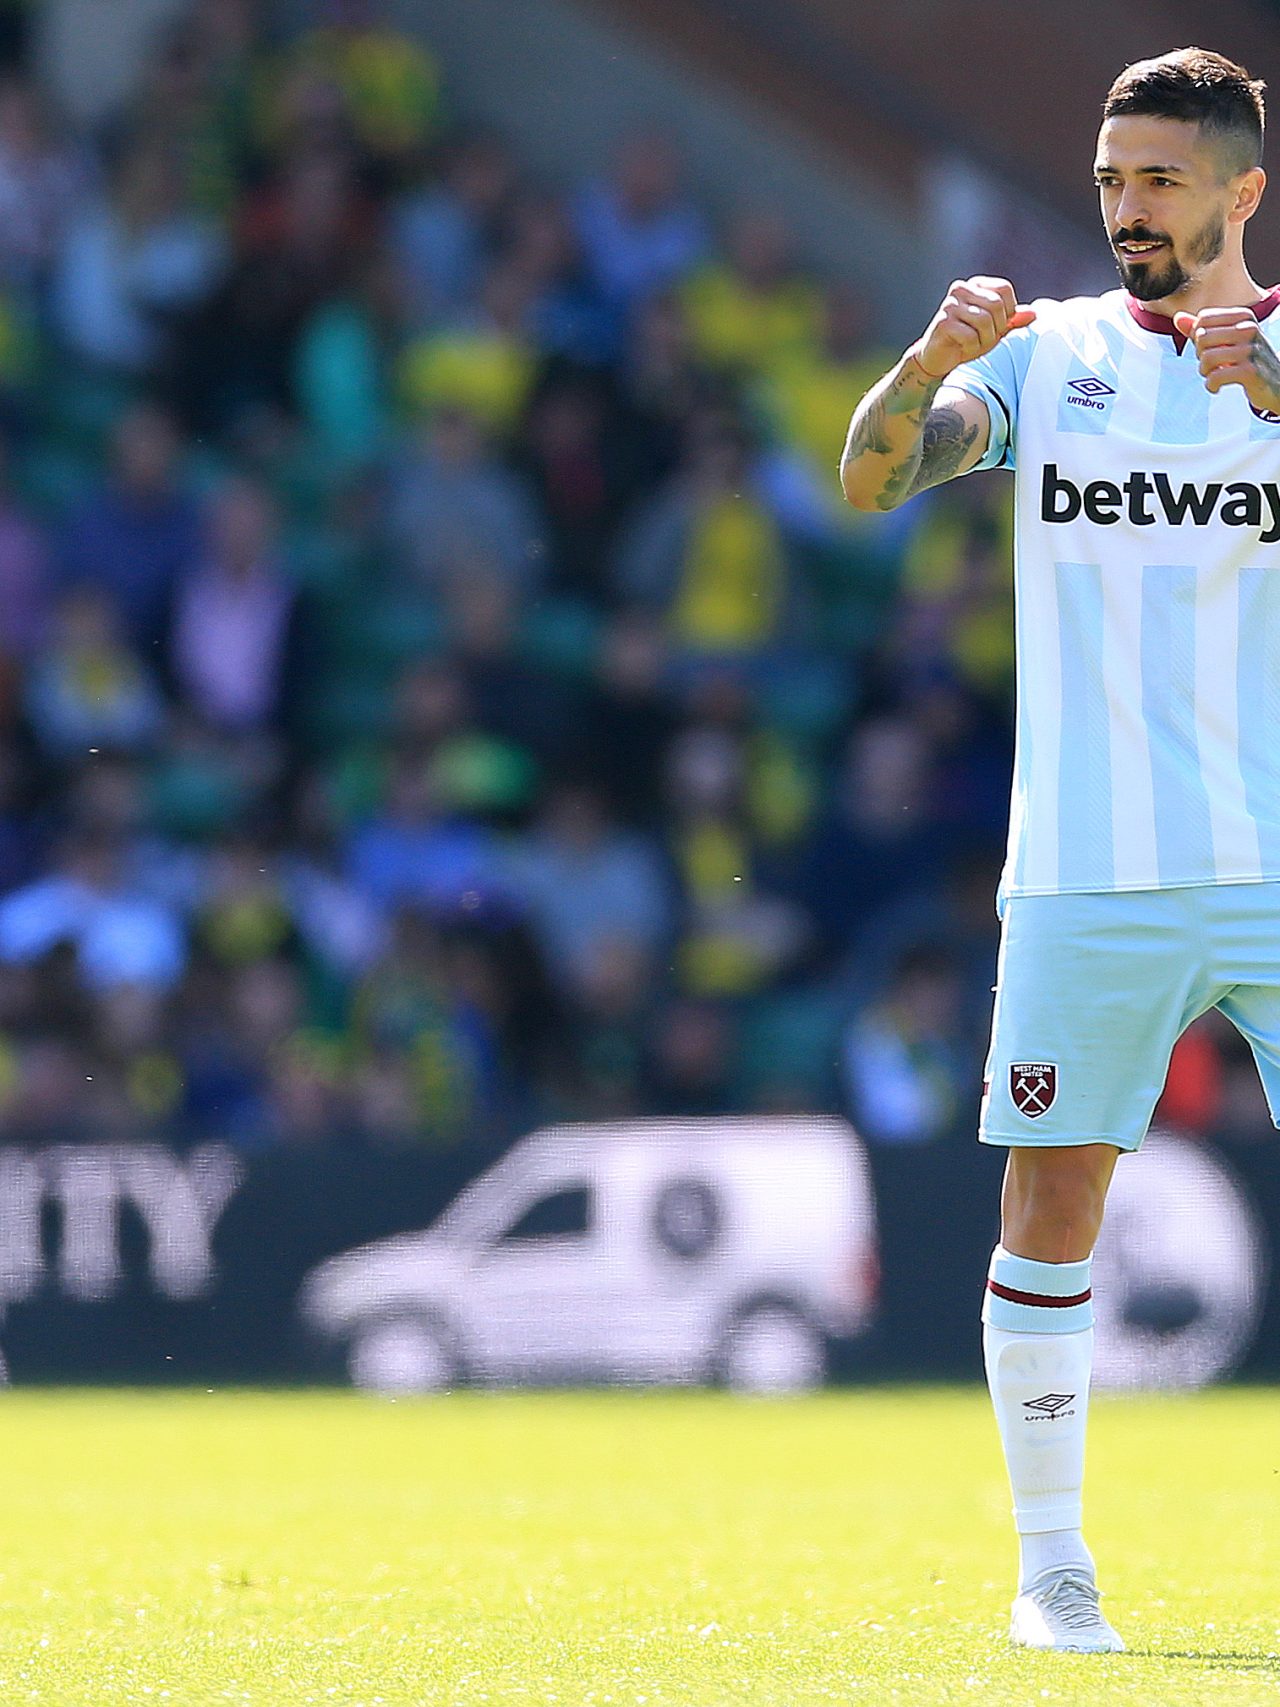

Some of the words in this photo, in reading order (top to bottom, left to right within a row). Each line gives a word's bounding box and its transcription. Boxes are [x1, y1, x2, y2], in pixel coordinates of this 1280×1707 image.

[1067, 395, 1105, 410] umbro
[1013, 1065, 1032, 1073] WEST
[1033, 1065, 1052, 1073] HAM
[1024, 1409, 1075, 1421] umbro
